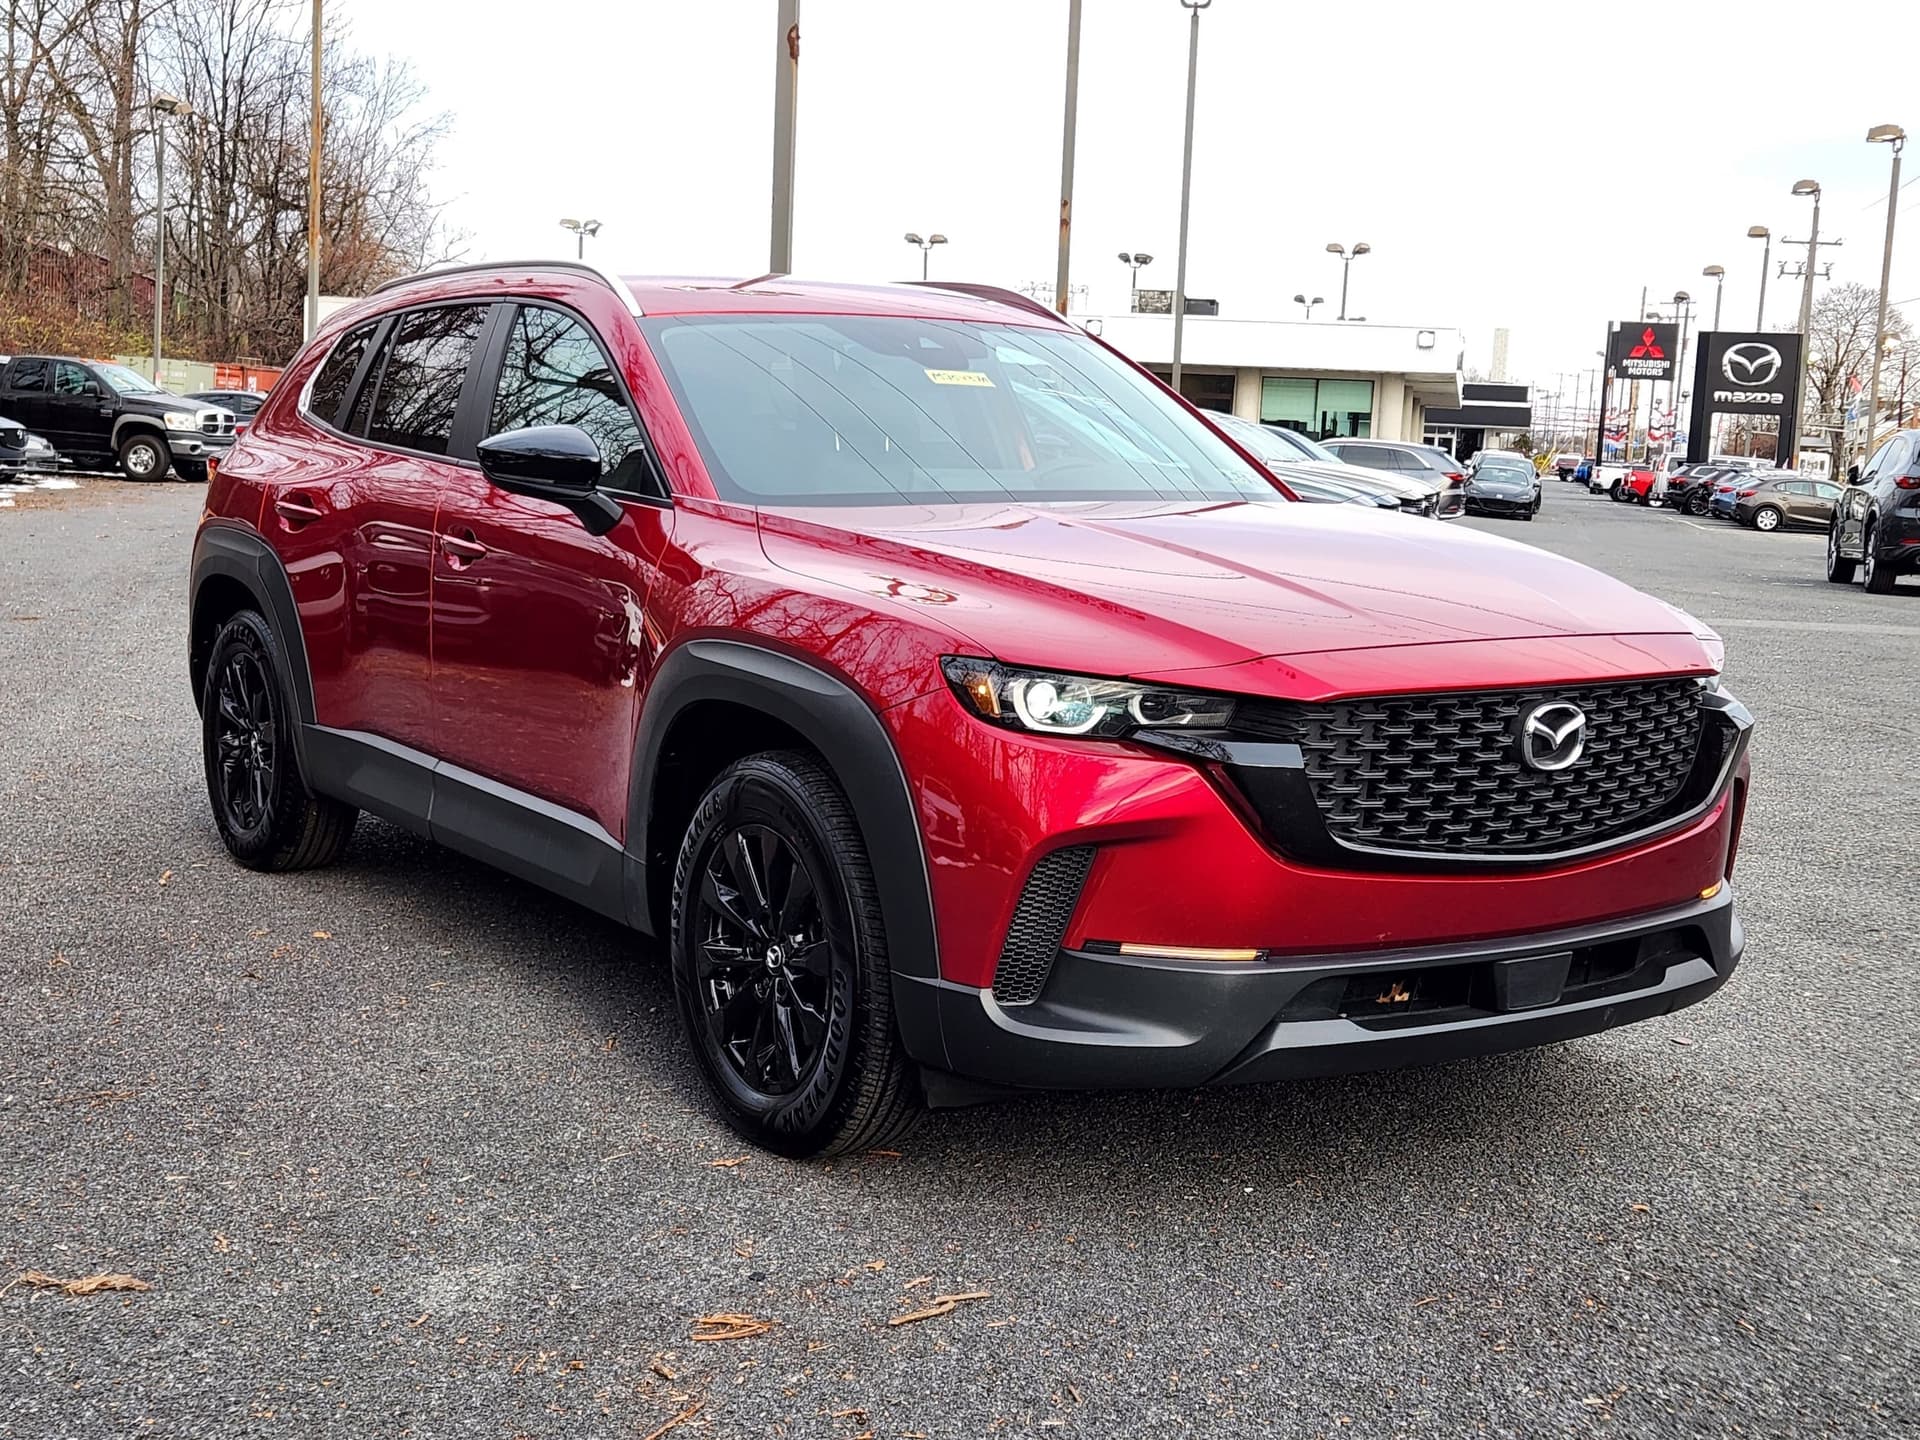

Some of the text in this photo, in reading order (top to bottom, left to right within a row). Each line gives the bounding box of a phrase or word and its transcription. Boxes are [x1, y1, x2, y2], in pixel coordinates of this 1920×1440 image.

[1622, 358, 1671, 369] MITSUBISHI
[1628, 367, 1663, 376] MOTORS
[782, 968, 848, 1134] GOODYEAR
